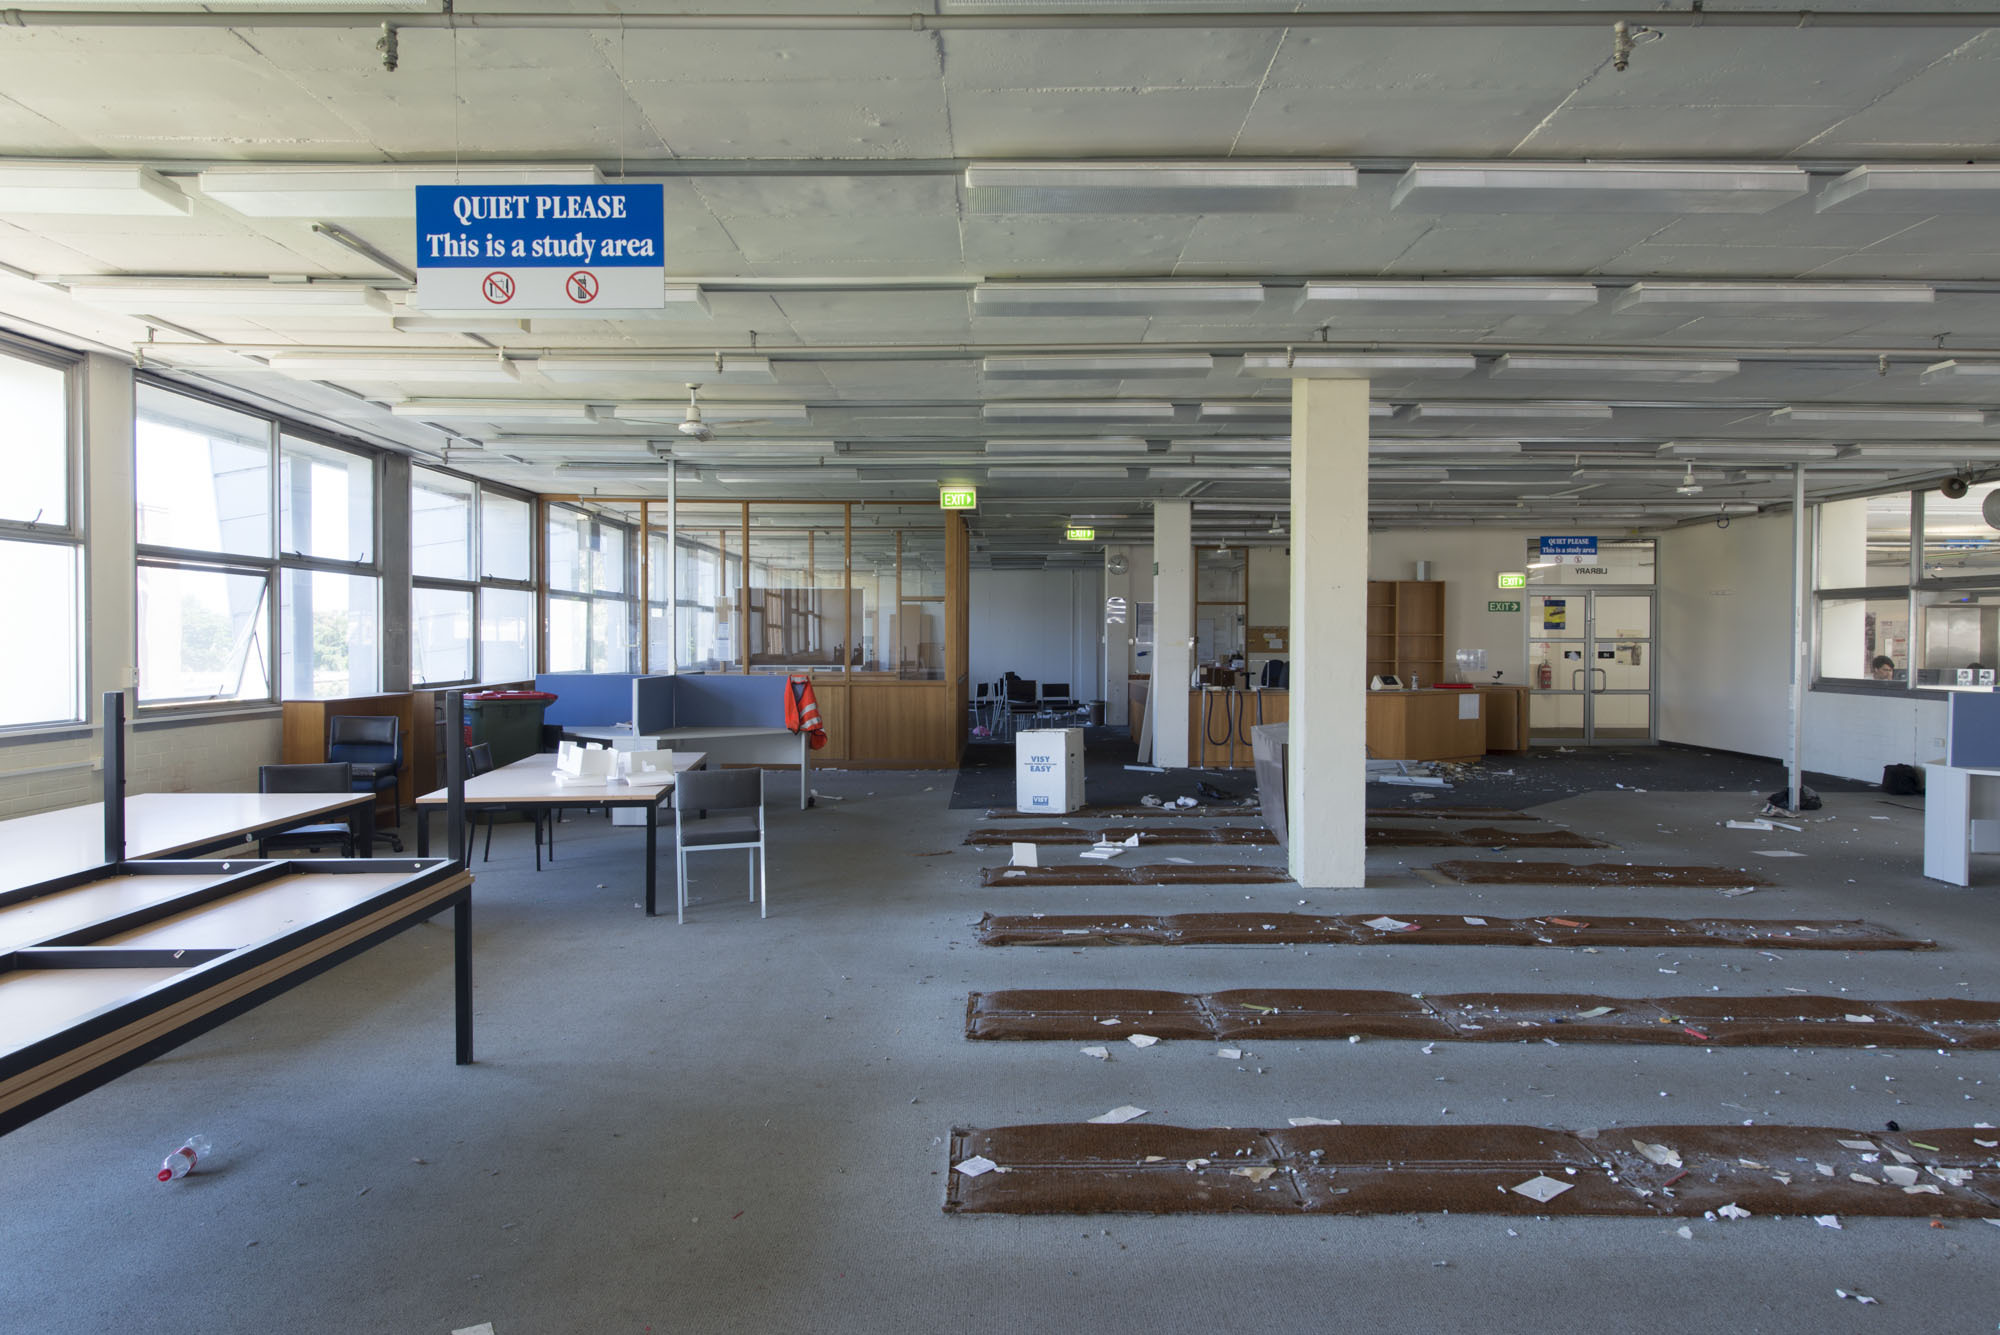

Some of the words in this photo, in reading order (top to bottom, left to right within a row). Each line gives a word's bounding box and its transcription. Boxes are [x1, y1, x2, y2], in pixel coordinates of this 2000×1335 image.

[453, 195, 529, 225] QUIET
[536, 195, 627, 219] PLEASE
[426, 232, 480, 258] This
[486, 232, 507, 258] is
[511, 240, 526, 257] a
[531, 232, 596, 264] study
[600, 238, 655, 257] area
[944, 494, 965, 506] EXIT
[1070, 529, 1087, 538] EXIT
[1548, 538, 1567, 546] QUIET
[1566, 547, 1582, 555] study
[1489, 602, 1510, 610] EXIT
